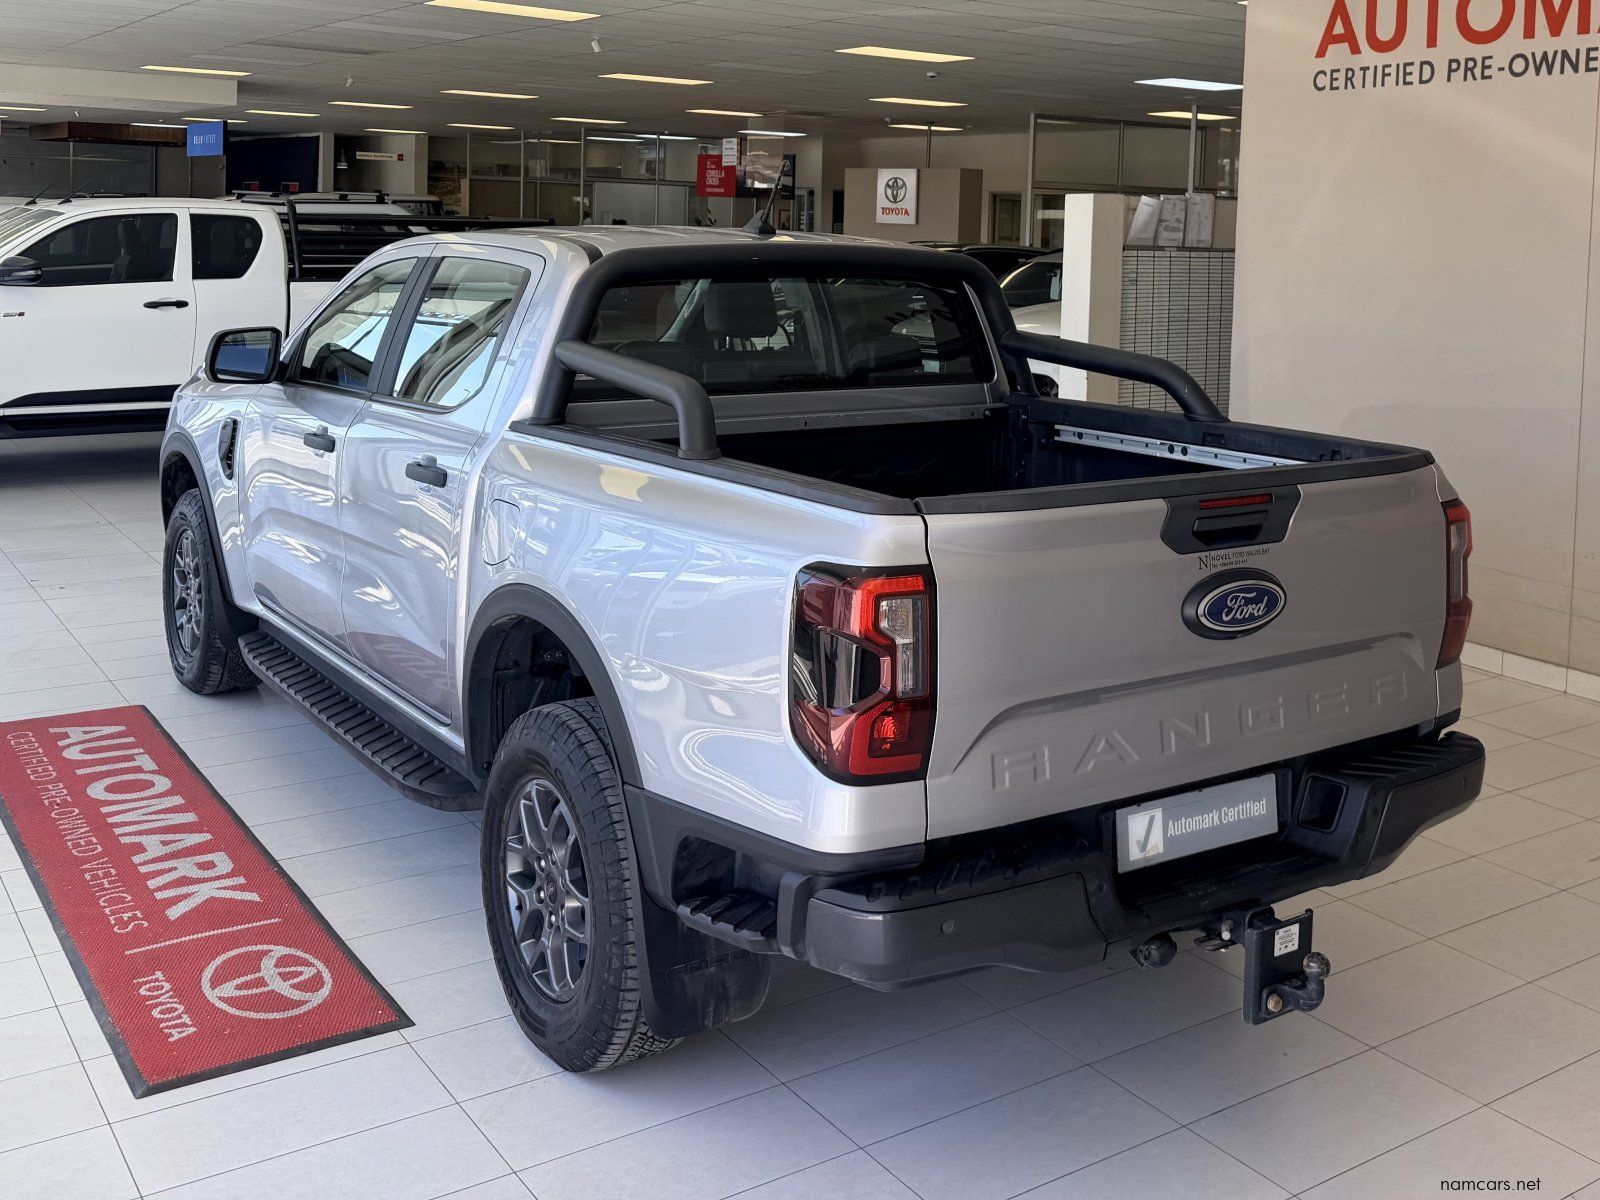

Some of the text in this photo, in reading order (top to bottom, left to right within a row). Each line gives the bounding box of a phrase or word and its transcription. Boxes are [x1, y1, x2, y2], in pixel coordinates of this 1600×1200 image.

[1314, 0, 1600, 58] AUTOM
[1312, 60, 1436, 92] CERTIFIED
[881, 206, 910, 216] TOYOTA
[1198, 555, 1208, 570] N
[1211, 553, 1231, 562] NOVEL
[1221, 592, 1268, 622] Ford
[991, 670, 1409, 791] RANGER
[6, 731, 149, 934] CERTIFIED PRE-OWNED VEHICLES
[48, 725, 262, 922] AUTOMARK
[1167, 797, 1267, 838] Automark Certified
[133, 970, 198, 1042] TOYOTA
